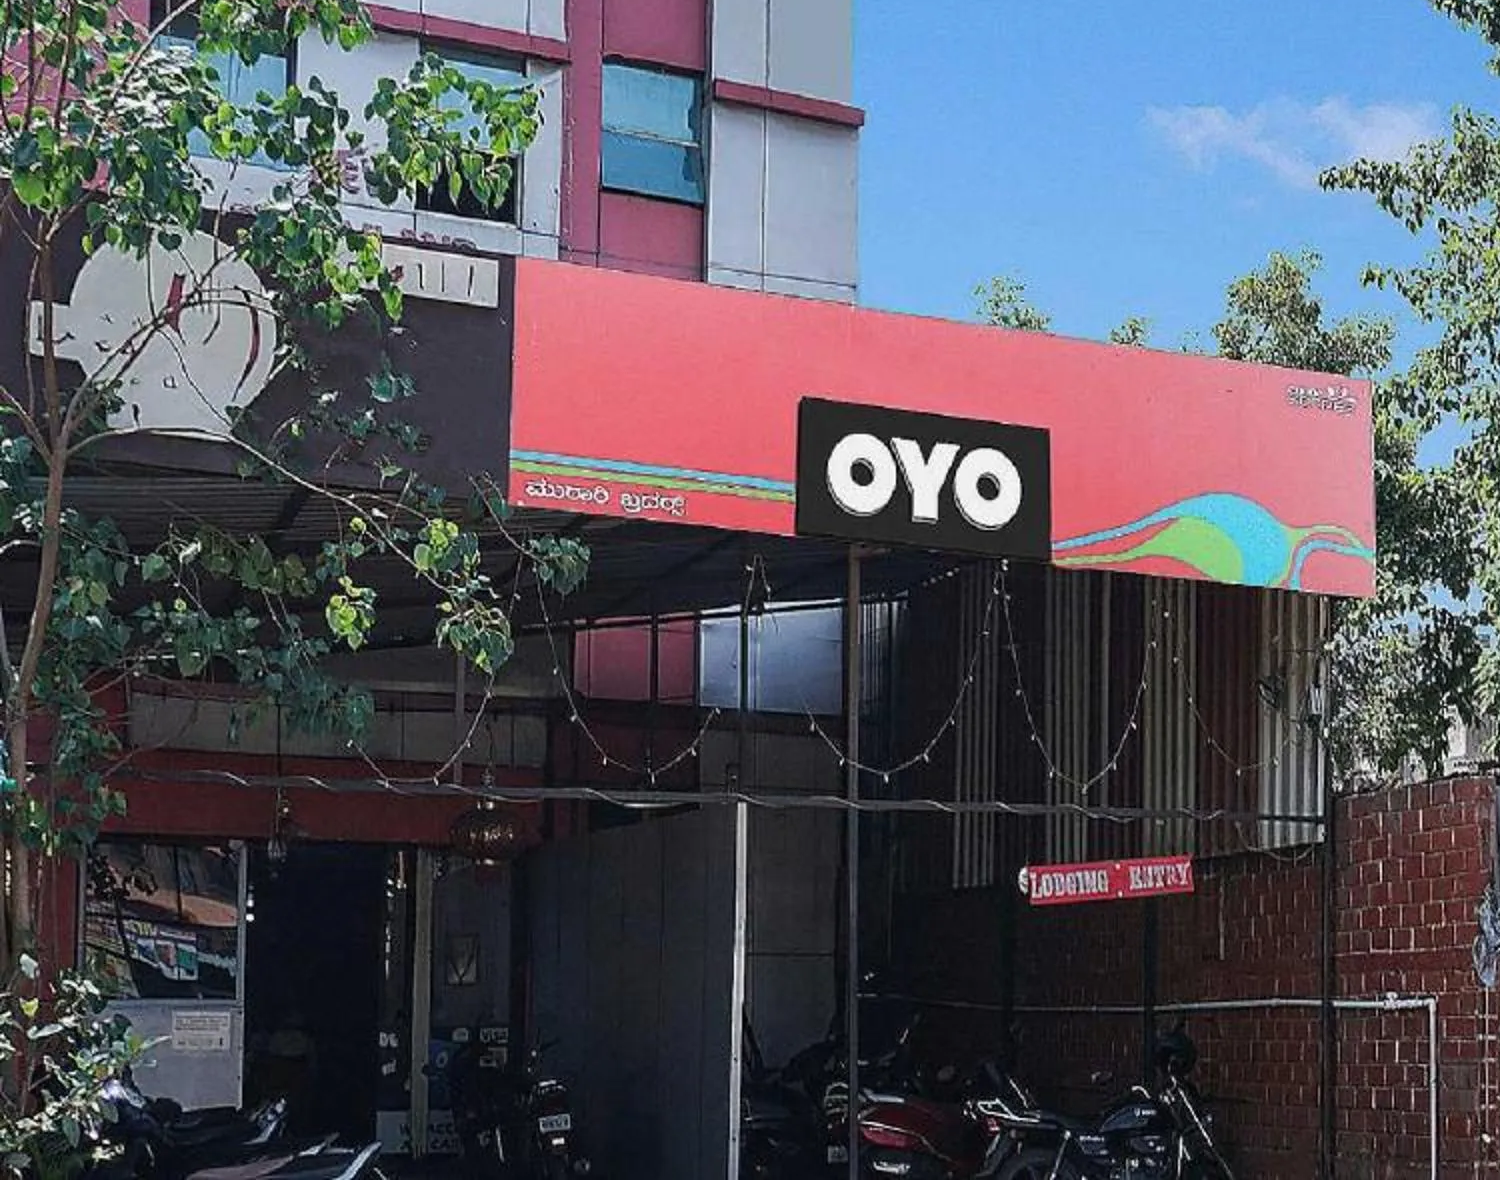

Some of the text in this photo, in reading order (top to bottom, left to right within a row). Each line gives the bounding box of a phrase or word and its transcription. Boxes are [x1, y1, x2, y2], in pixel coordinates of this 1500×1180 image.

[827, 433, 1022, 531] OYO
[1030, 860, 1191, 899] LODGING ENTRY
